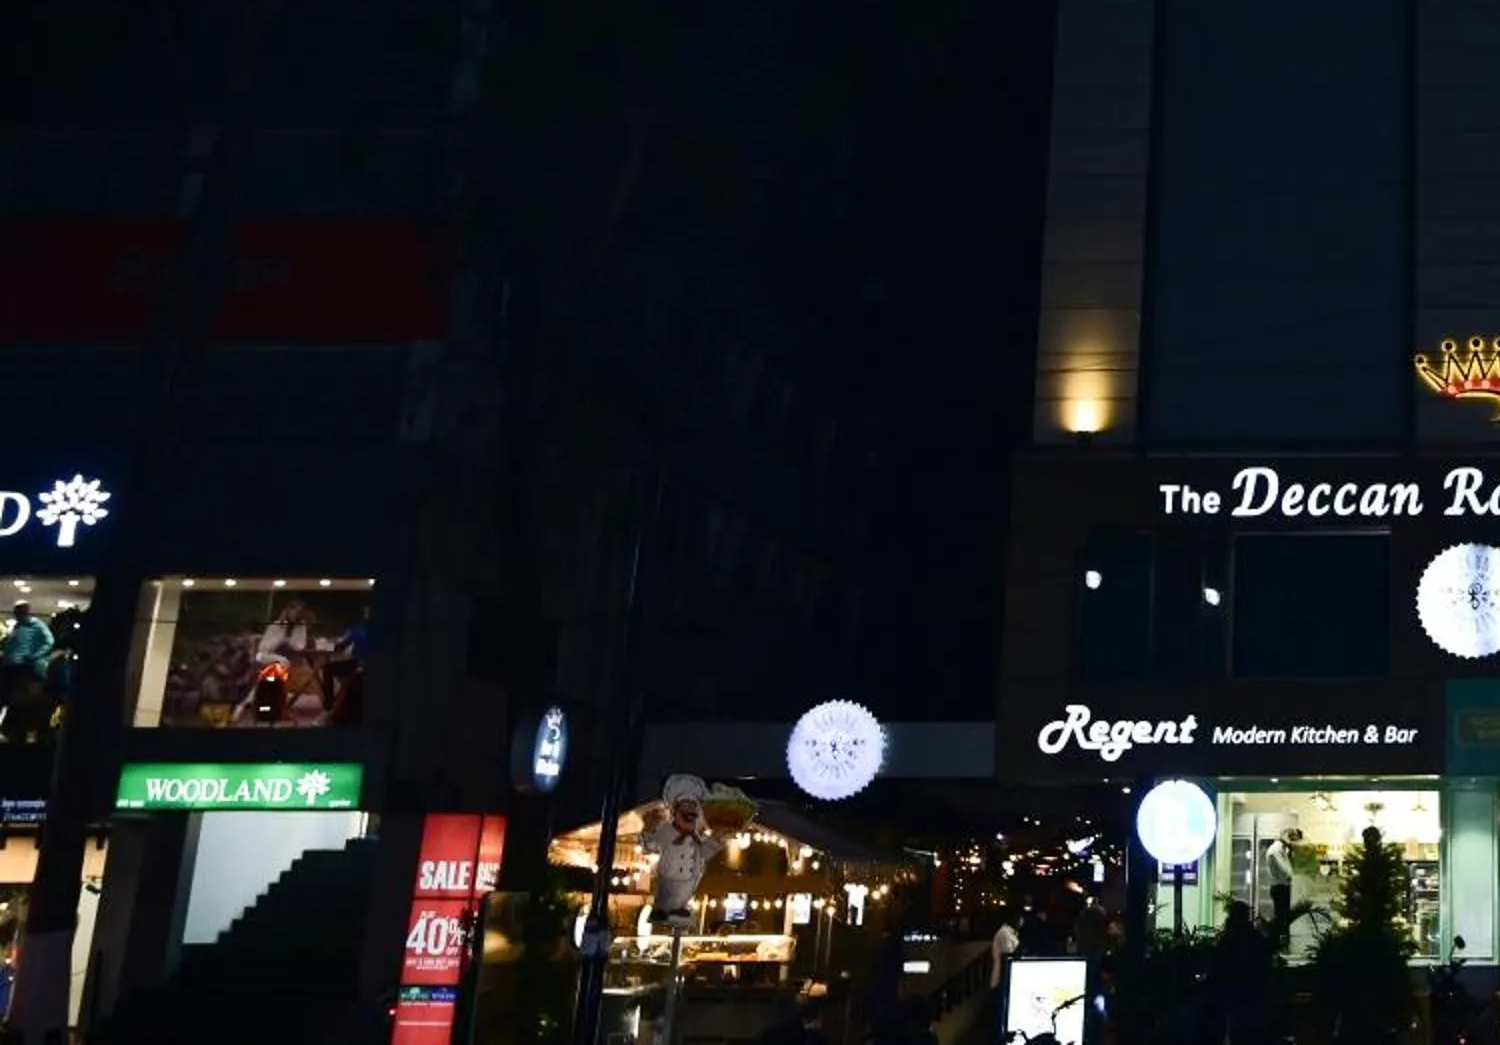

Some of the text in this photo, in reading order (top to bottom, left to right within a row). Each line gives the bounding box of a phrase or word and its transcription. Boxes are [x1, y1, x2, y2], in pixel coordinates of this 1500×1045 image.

[1159, 483, 1221, 515] The
[1230, 466, 1424, 517] Deccan
[1037, 704, 1419, 762] Regent Modern Kitchen & Bar
[145, 778, 293, 802] WOODLAND
[419, 860, 471, 891] SALE
[406, 917, 466, 956] 40%
